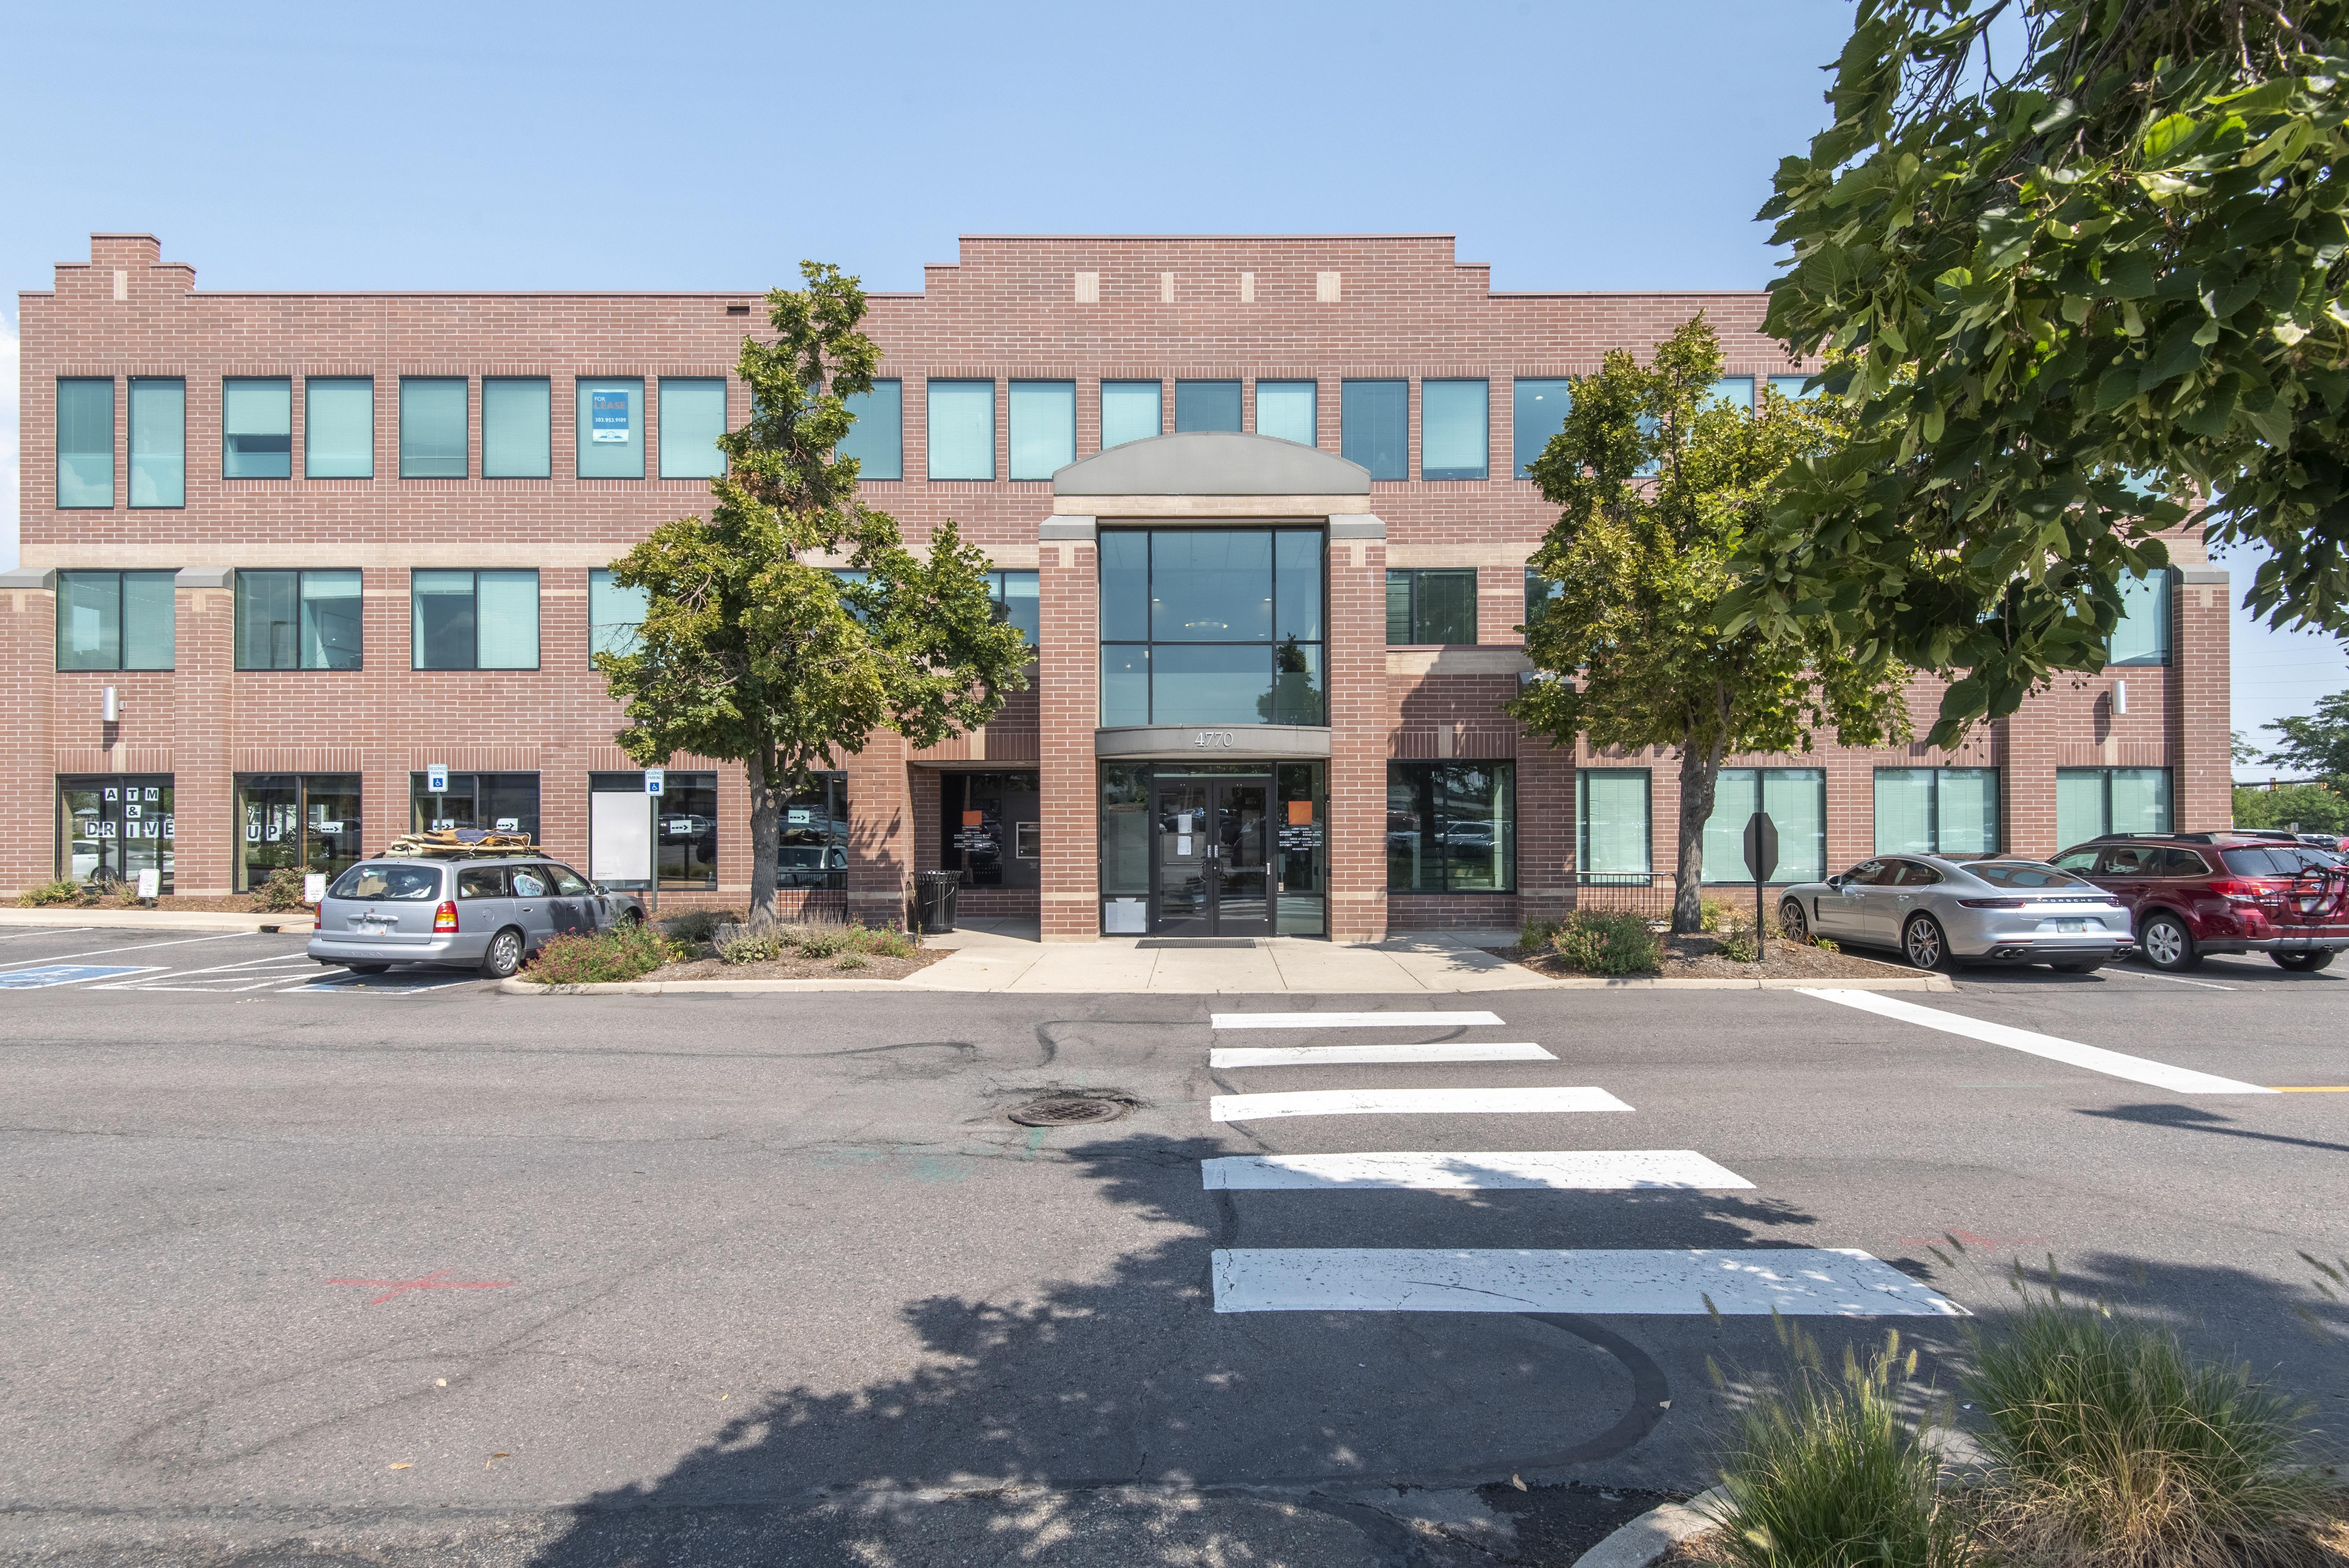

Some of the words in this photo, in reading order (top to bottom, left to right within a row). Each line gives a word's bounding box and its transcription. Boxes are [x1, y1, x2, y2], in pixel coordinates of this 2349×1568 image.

[1194, 732, 1234, 747] 4770
[128, 806, 138, 815] &
[87, 822, 174, 837] DRIVE
[248, 826, 277, 839] UP
